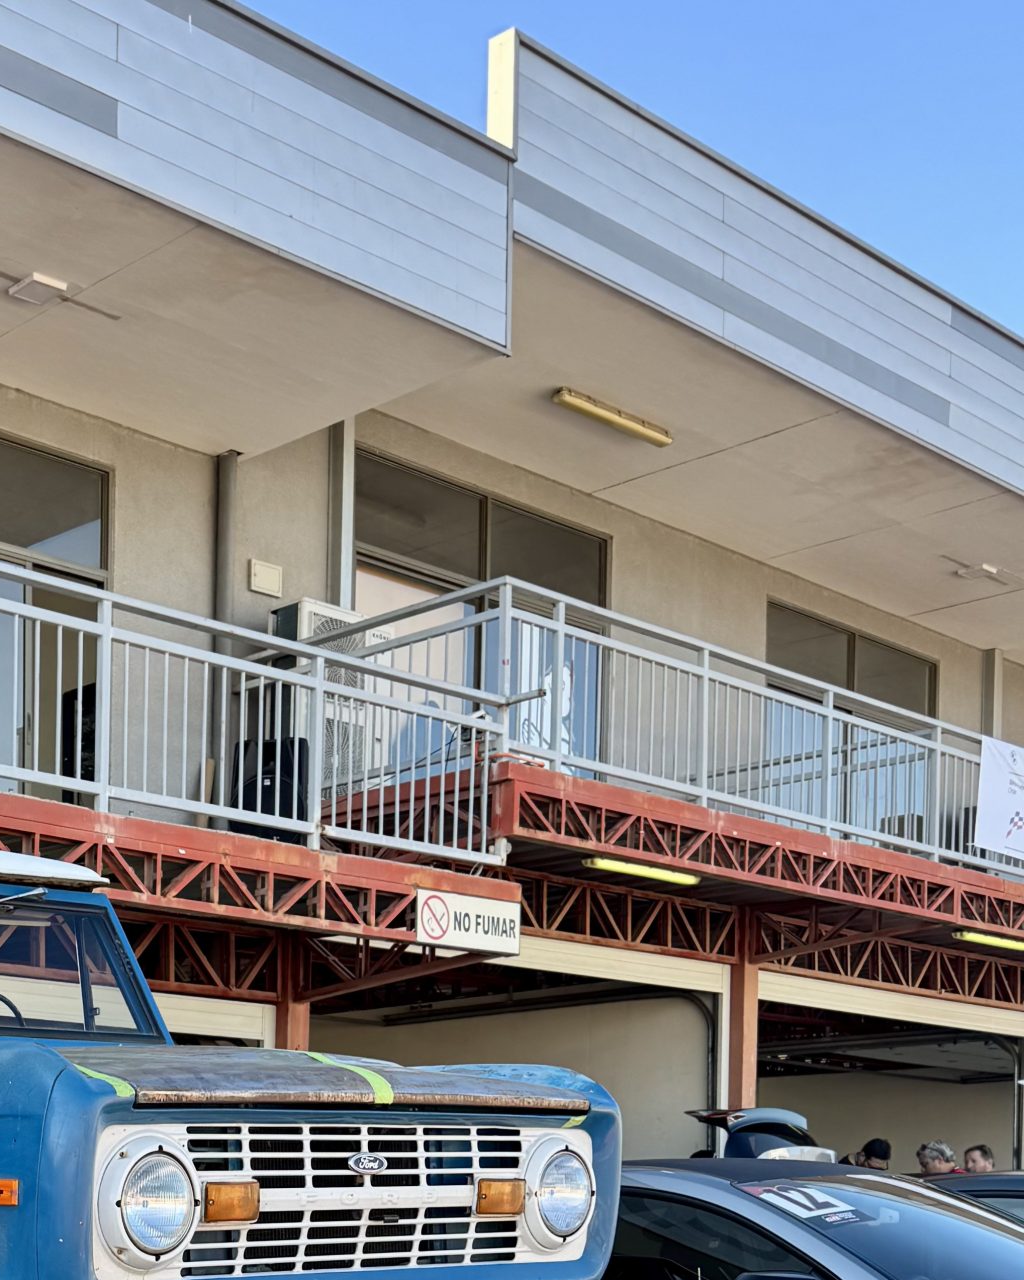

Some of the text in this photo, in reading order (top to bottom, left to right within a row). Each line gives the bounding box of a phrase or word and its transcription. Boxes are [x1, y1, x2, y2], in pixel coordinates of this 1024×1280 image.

[453, 911, 517, 938] NO FUMAR
[358, 1156, 379, 1169] Ford
[762, 1184, 839, 1212] 12
